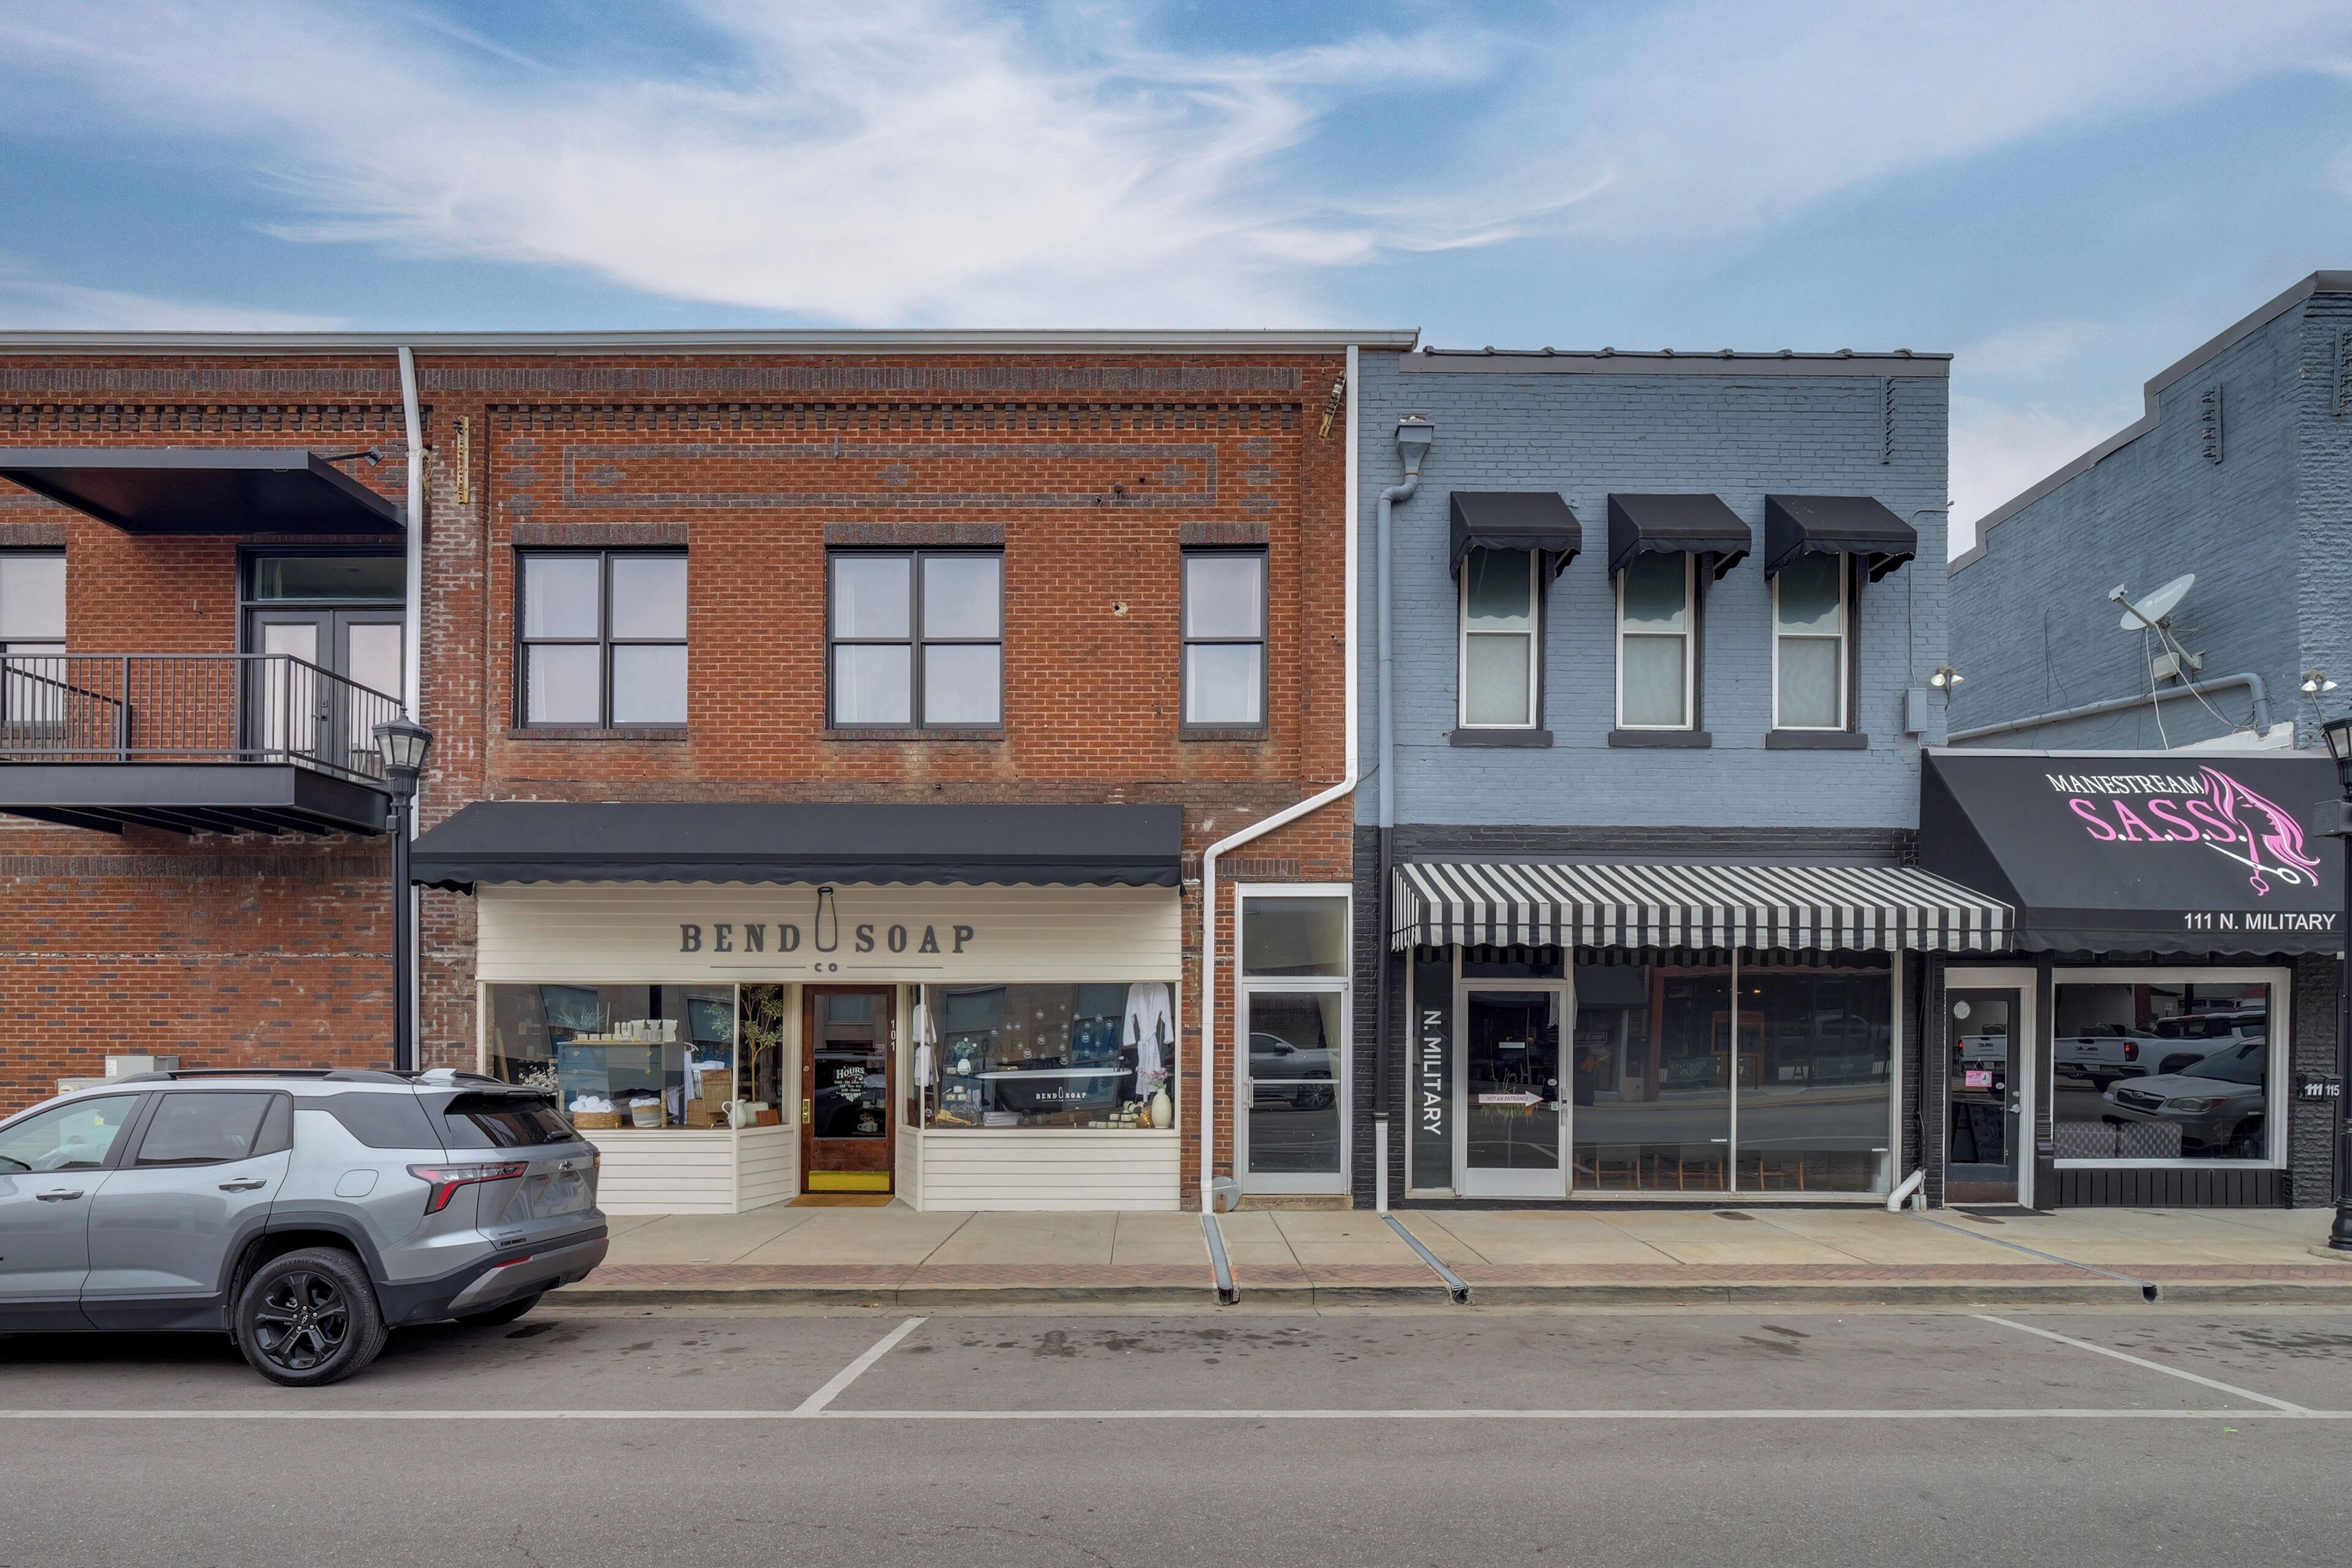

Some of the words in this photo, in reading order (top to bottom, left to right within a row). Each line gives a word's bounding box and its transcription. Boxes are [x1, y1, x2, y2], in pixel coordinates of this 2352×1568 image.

[2153, 582, 2183, 604] DIRECTV
[2045, 774, 2205, 794] MANESTREAM
[2069, 798, 2248, 843] S.A.S.S.
[2184, 912, 2212, 929] 111
[2219, 913, 2239, 930] N.
[2245, 913, 2337, 931] MILITARY
[679, 924, 801, 953] BEND
[855, 924, 974, 954] SOAP
[814, 962, 838, 973] CO
[1423, 1010, 1442, 1030] N.
[836, 1067, 865, 1079] HOURS
[1423, 1037, 1442, 1135] MILITARY
[2325, 1084, 2340, 1097] 115
